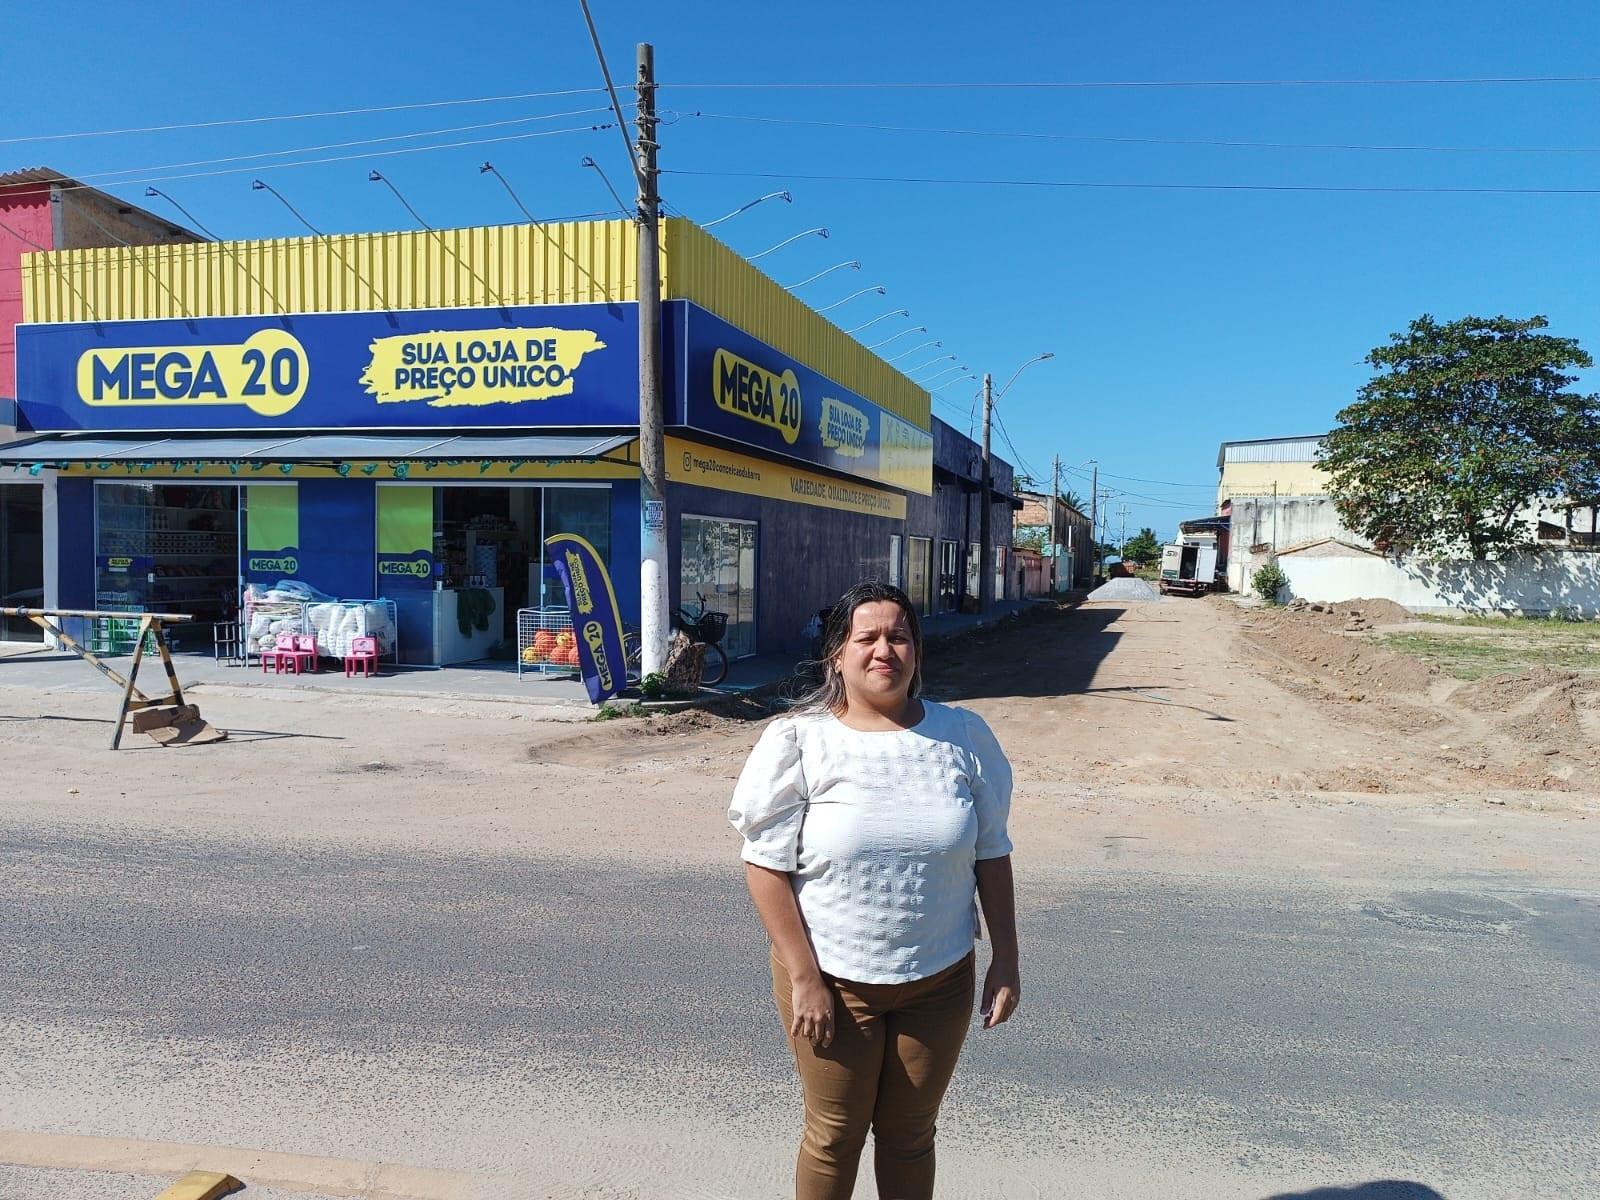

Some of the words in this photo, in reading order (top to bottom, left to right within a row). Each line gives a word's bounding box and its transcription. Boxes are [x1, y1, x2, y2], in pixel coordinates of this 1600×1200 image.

[401, 342, 450, 365] SUA
[456, 339, 519, 363] LOJA
[526, 338, 557, 362] DE
[92, 350, 228, 401] MEGA
[241, 347, 299, 396] 20
[395, 366, 476, 396] PREÇO
[483, 363, 565, 388] UNICO
[720, 354, 776, 423] MEGA
[780, 382, 799, 429] 20
[829, 404, 841, 425] SUA
[841, 409, 854, 429] LOJA
[855, 416, 862, 433] DE
[827, 422, 847, 447] PREÇO
[790, 476, 827, 499] VARIEDADE,
[828, 484, 857, 504] QUALIDADE
[252, 560, 282, 570] MEGA
[283, 560, 296, 570] 20
[381, 562, 413, 573] MEGA
[415, 563, 429, 573] 20
[586, 623, 600, 641] 20
[593, 643, 611, 687] MEGA
